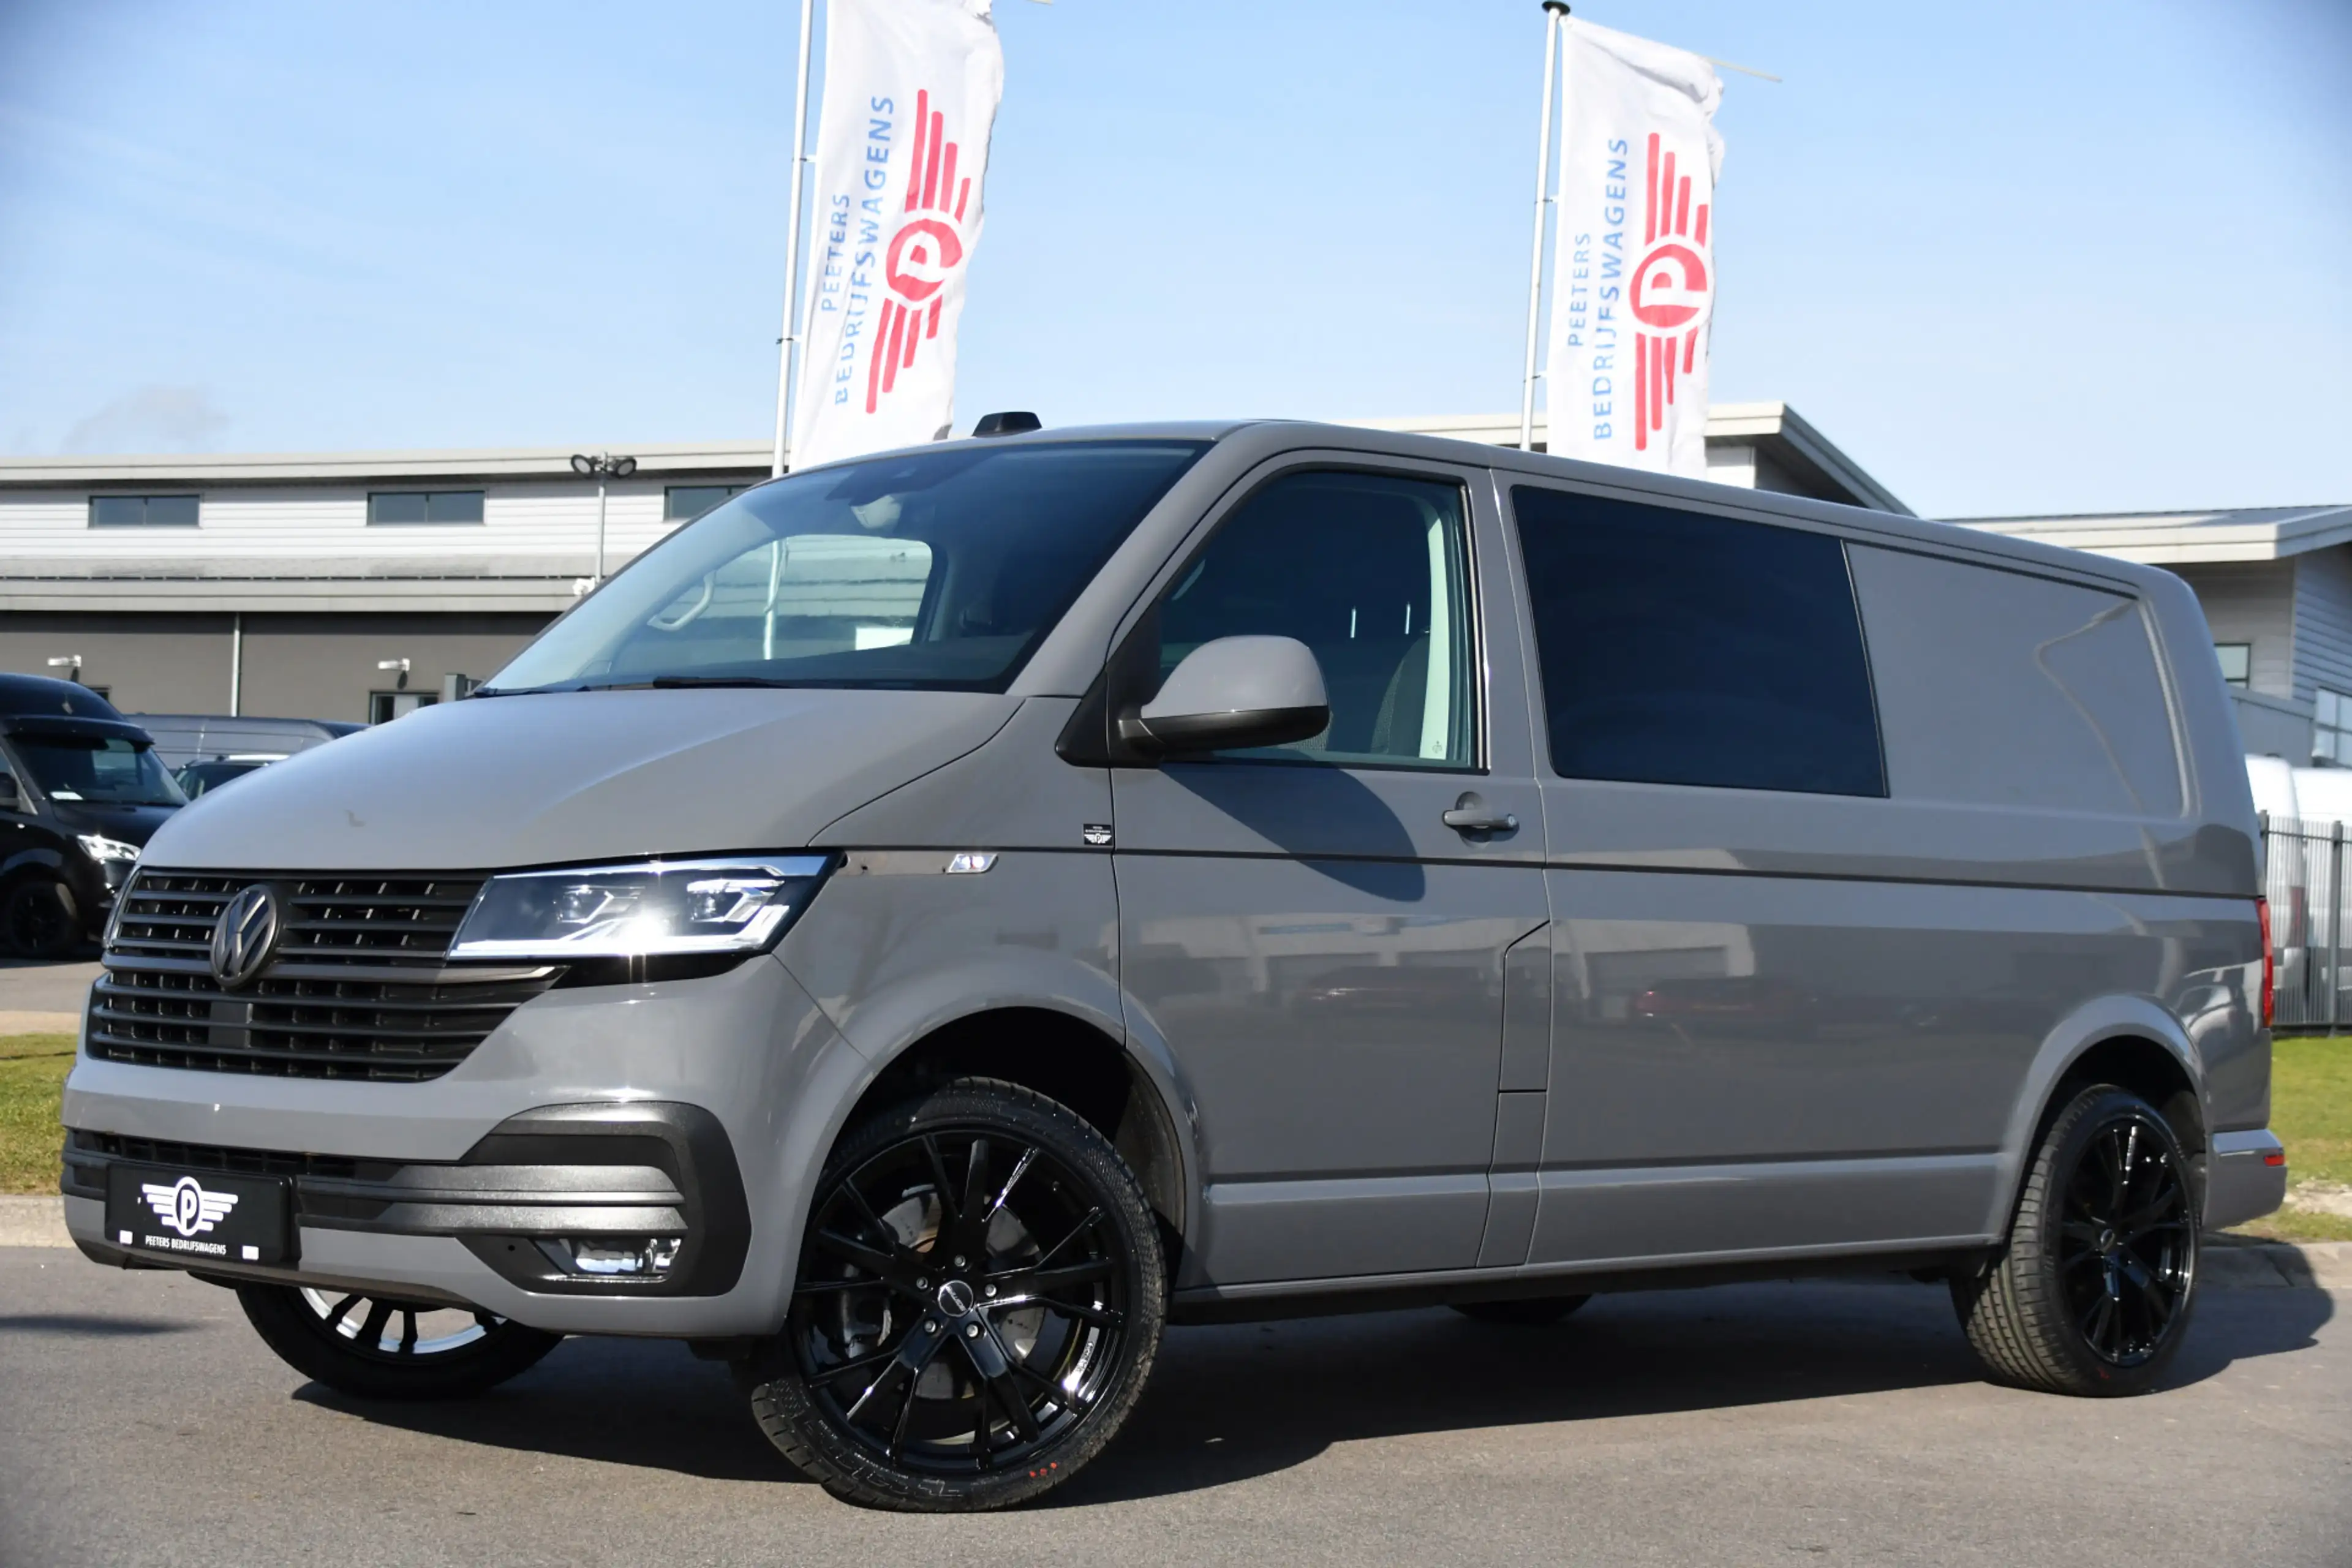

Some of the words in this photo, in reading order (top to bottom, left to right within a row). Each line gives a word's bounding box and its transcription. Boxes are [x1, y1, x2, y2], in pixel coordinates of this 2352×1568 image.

[821, 193, 850, 312] PEETERS
[835, 96, 894, 405] BEDRIJFSWAGENS
[1568, 233, 1591, 347] PEETERS
[1593, 138, 1628, 440] BEDRIJFSWAGENS
[145, 1235, 170, 1248] PEETERS
